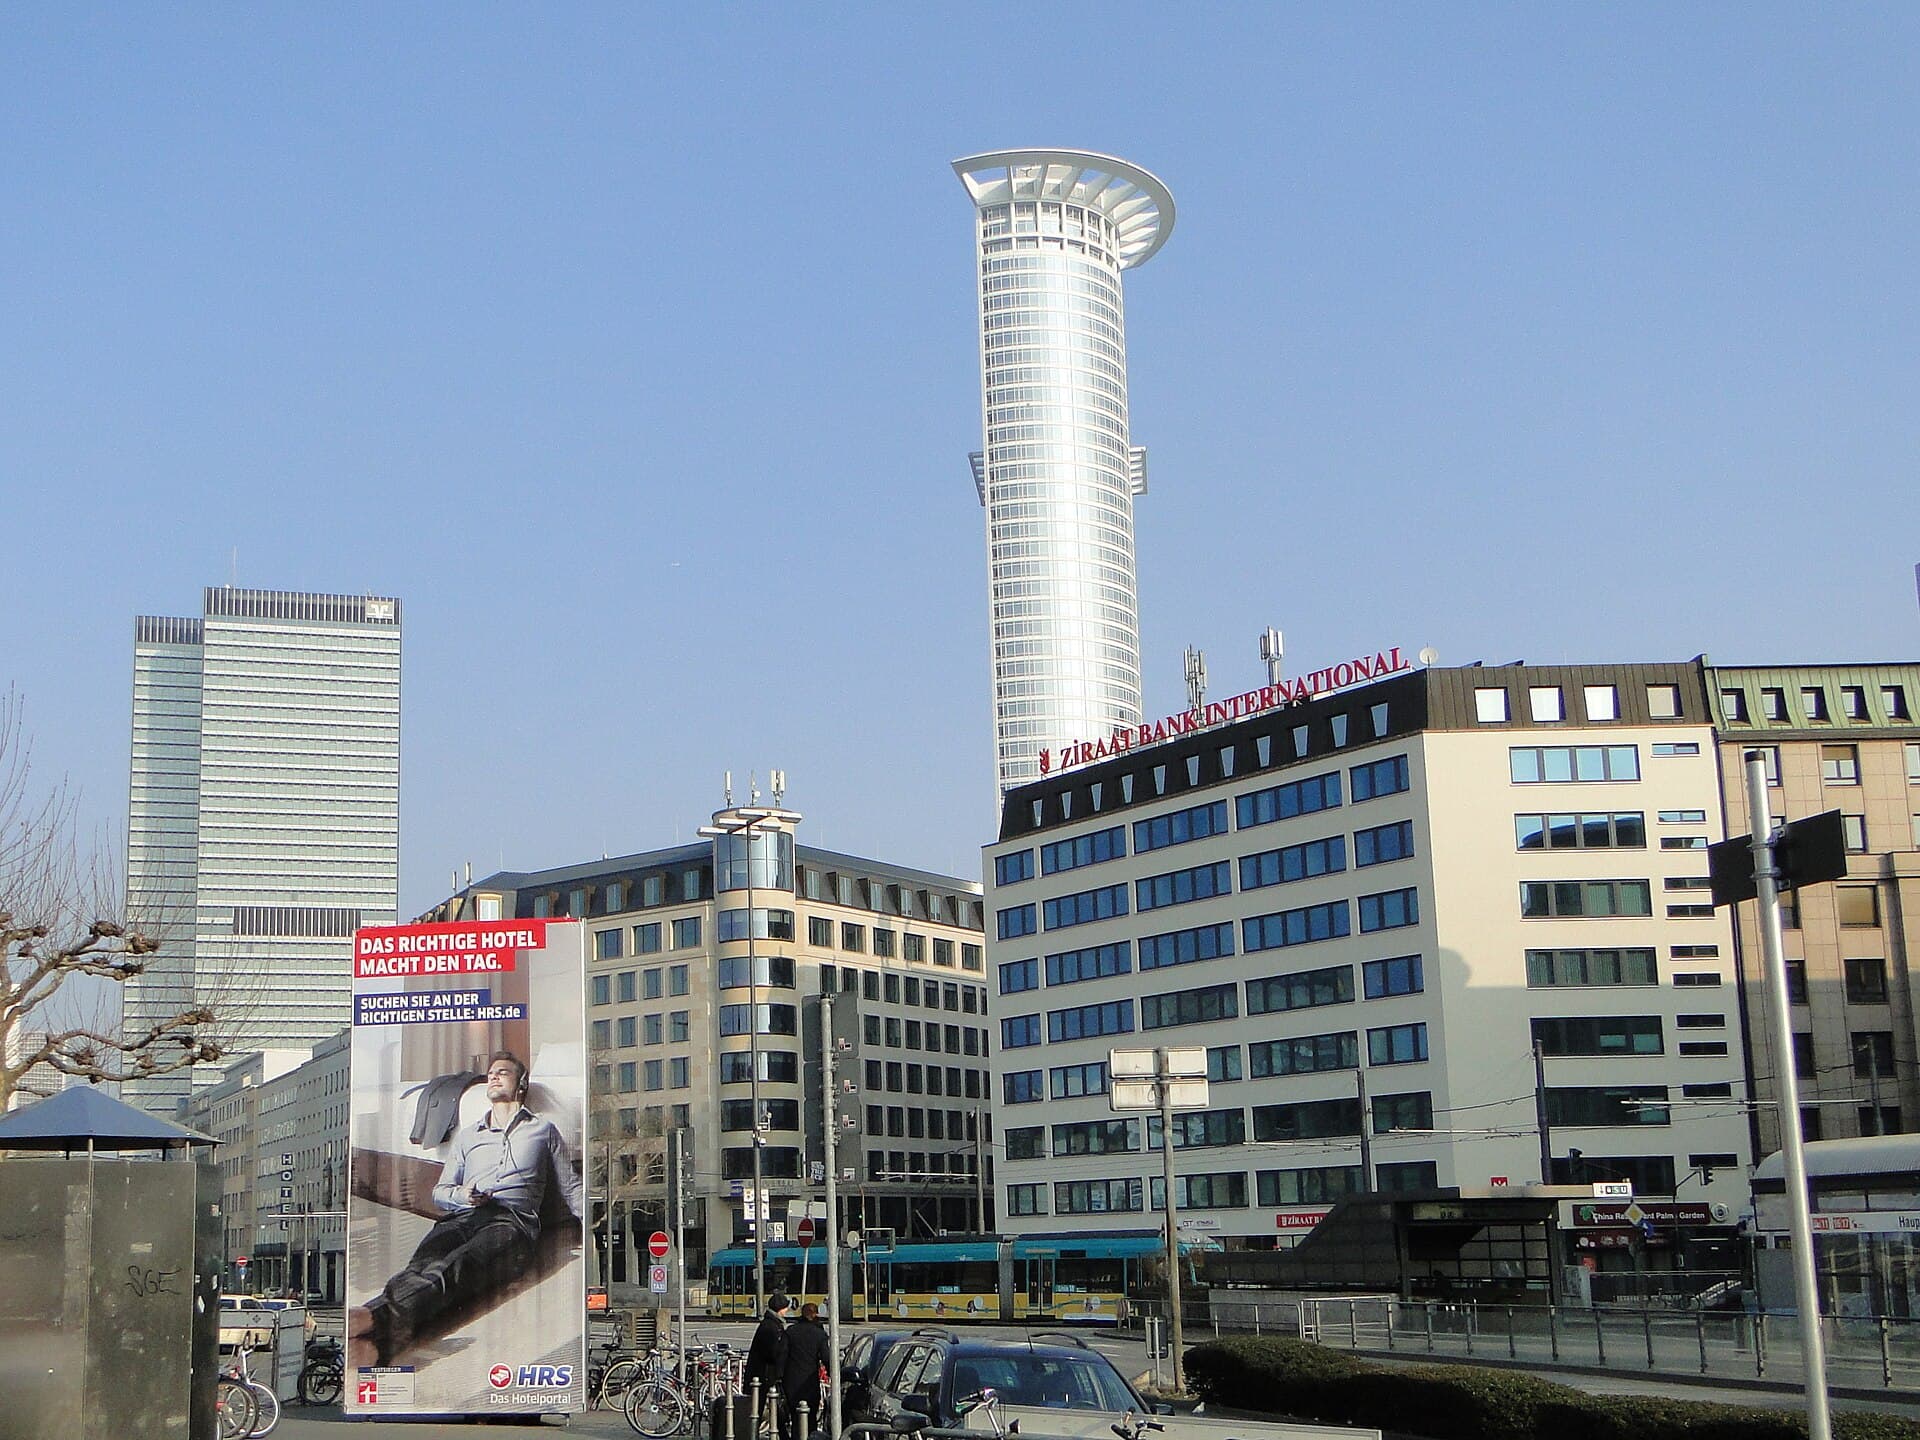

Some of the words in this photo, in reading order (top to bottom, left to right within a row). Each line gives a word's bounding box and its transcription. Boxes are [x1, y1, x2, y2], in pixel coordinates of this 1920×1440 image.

[1138, 707, 1200, 746] BANK
[1205, 647, 1410, 726] INTERNATIONAL
[360, 936, 395, 955] DAS
[398, 932, 477, 953] RICHTIGE
[481, 930, 537, 949] HOTEL
[360, 956, 421, 976] MACHT
[424, 954, 460, 972] DEN
[463, 952, 502, 971] TAG.
[360, 995, 409, 1010] SUCHEN
[411, 994, 432, 1007] SIE
[433, 993, 453, 1007] AN
[454, 993, 479, 1006] DER
[360, 1009, 425, 1025] RICHTIGEN
[427, 1008, 475, 1022] STELLE:
[477, 1005, 521, 1020] HRS.de
[281, 1154, 293, 1231] HOTEL
[1679, 1212, 1706, 1220] Garden
[125, 1265, 183, 1297] SGE
[517, 1365, 573, 1387] HRS
[490, 1394, 509, 1404] Das
[512, 1392, 571, 1407] Hotelportal
